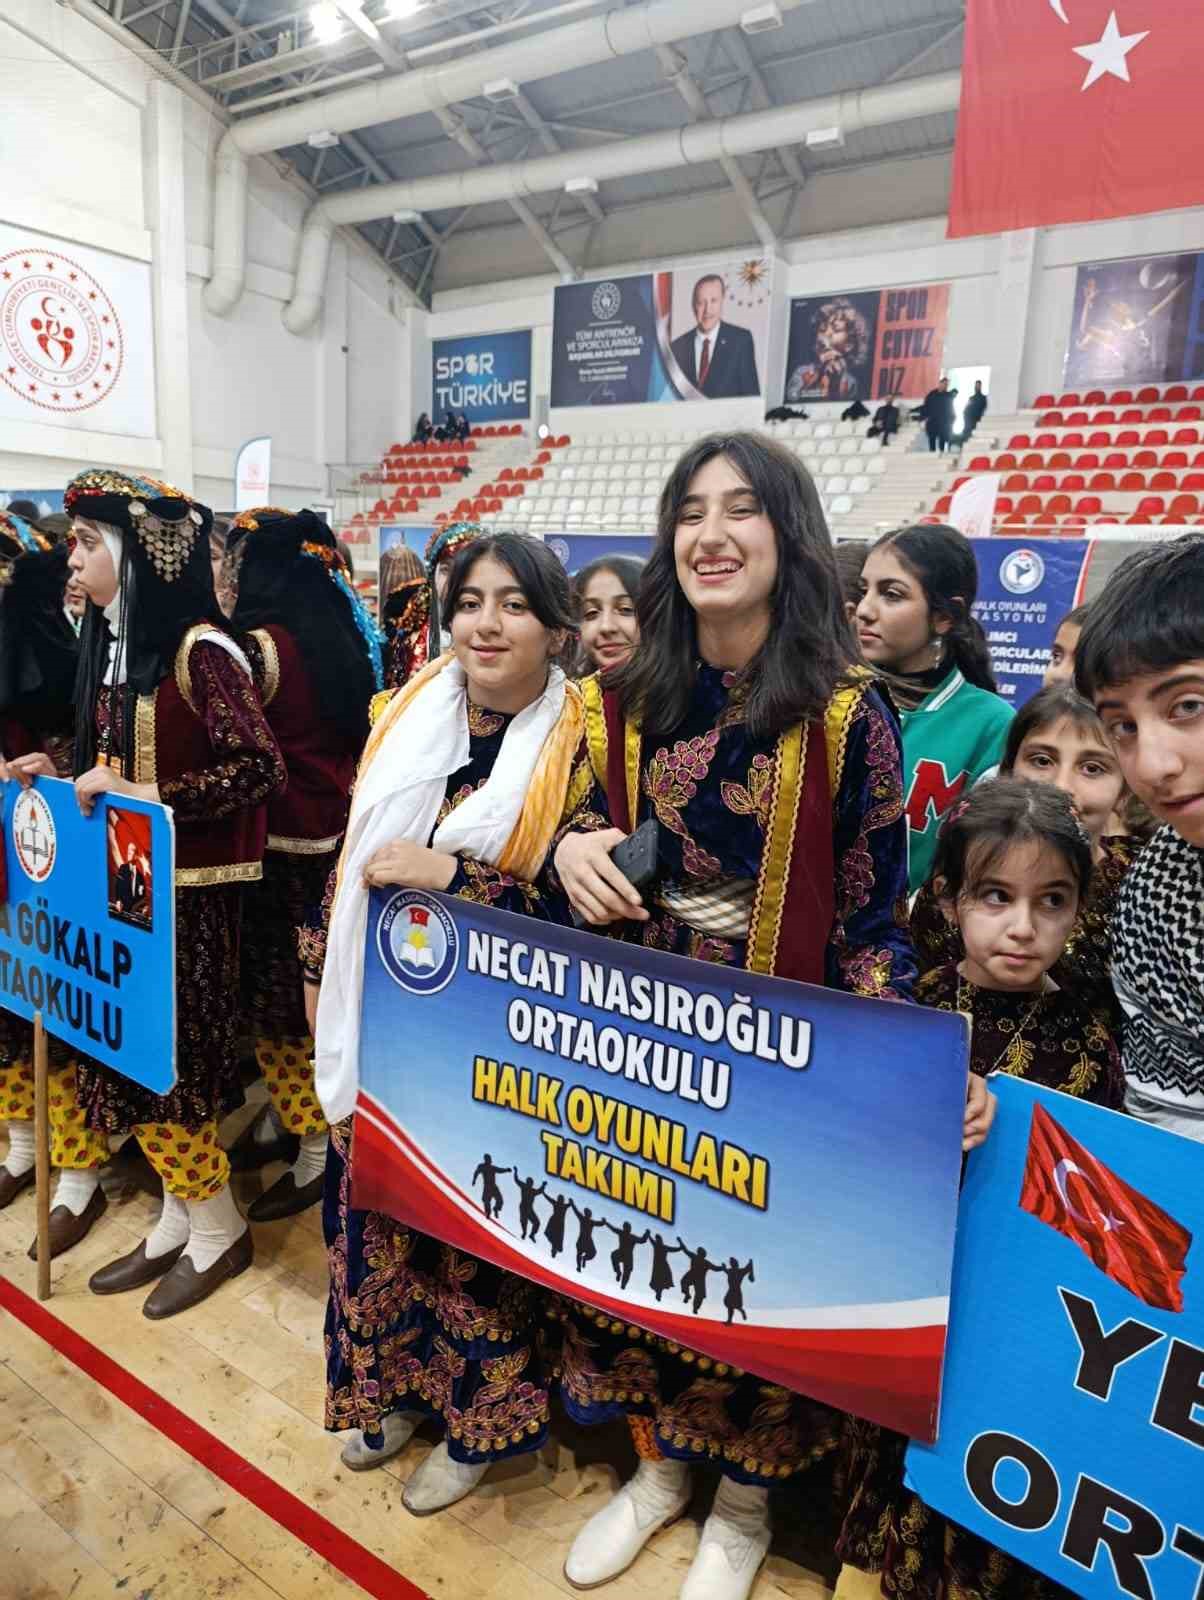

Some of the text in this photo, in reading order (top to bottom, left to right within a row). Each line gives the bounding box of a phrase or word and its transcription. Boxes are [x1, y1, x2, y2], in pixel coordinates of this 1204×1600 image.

[436, 352, 494, 379] SPOR
[436, 378, 527, 409] TÜRKİYE
[988, 646, 1053, 660] ORCULAR
[17, 896, 132, 989] GÖKALP
[0, 950, 122, 1051] TAOKULU
[467, 929, 812, 1071] NECAT NASIROĞLU
[507, 998, 731, 1111] ORTAOKULU
[473, 1056, 770, 1211] HALK OYUNLARI
[541, 1131, 676, 1225] TAKIMI
